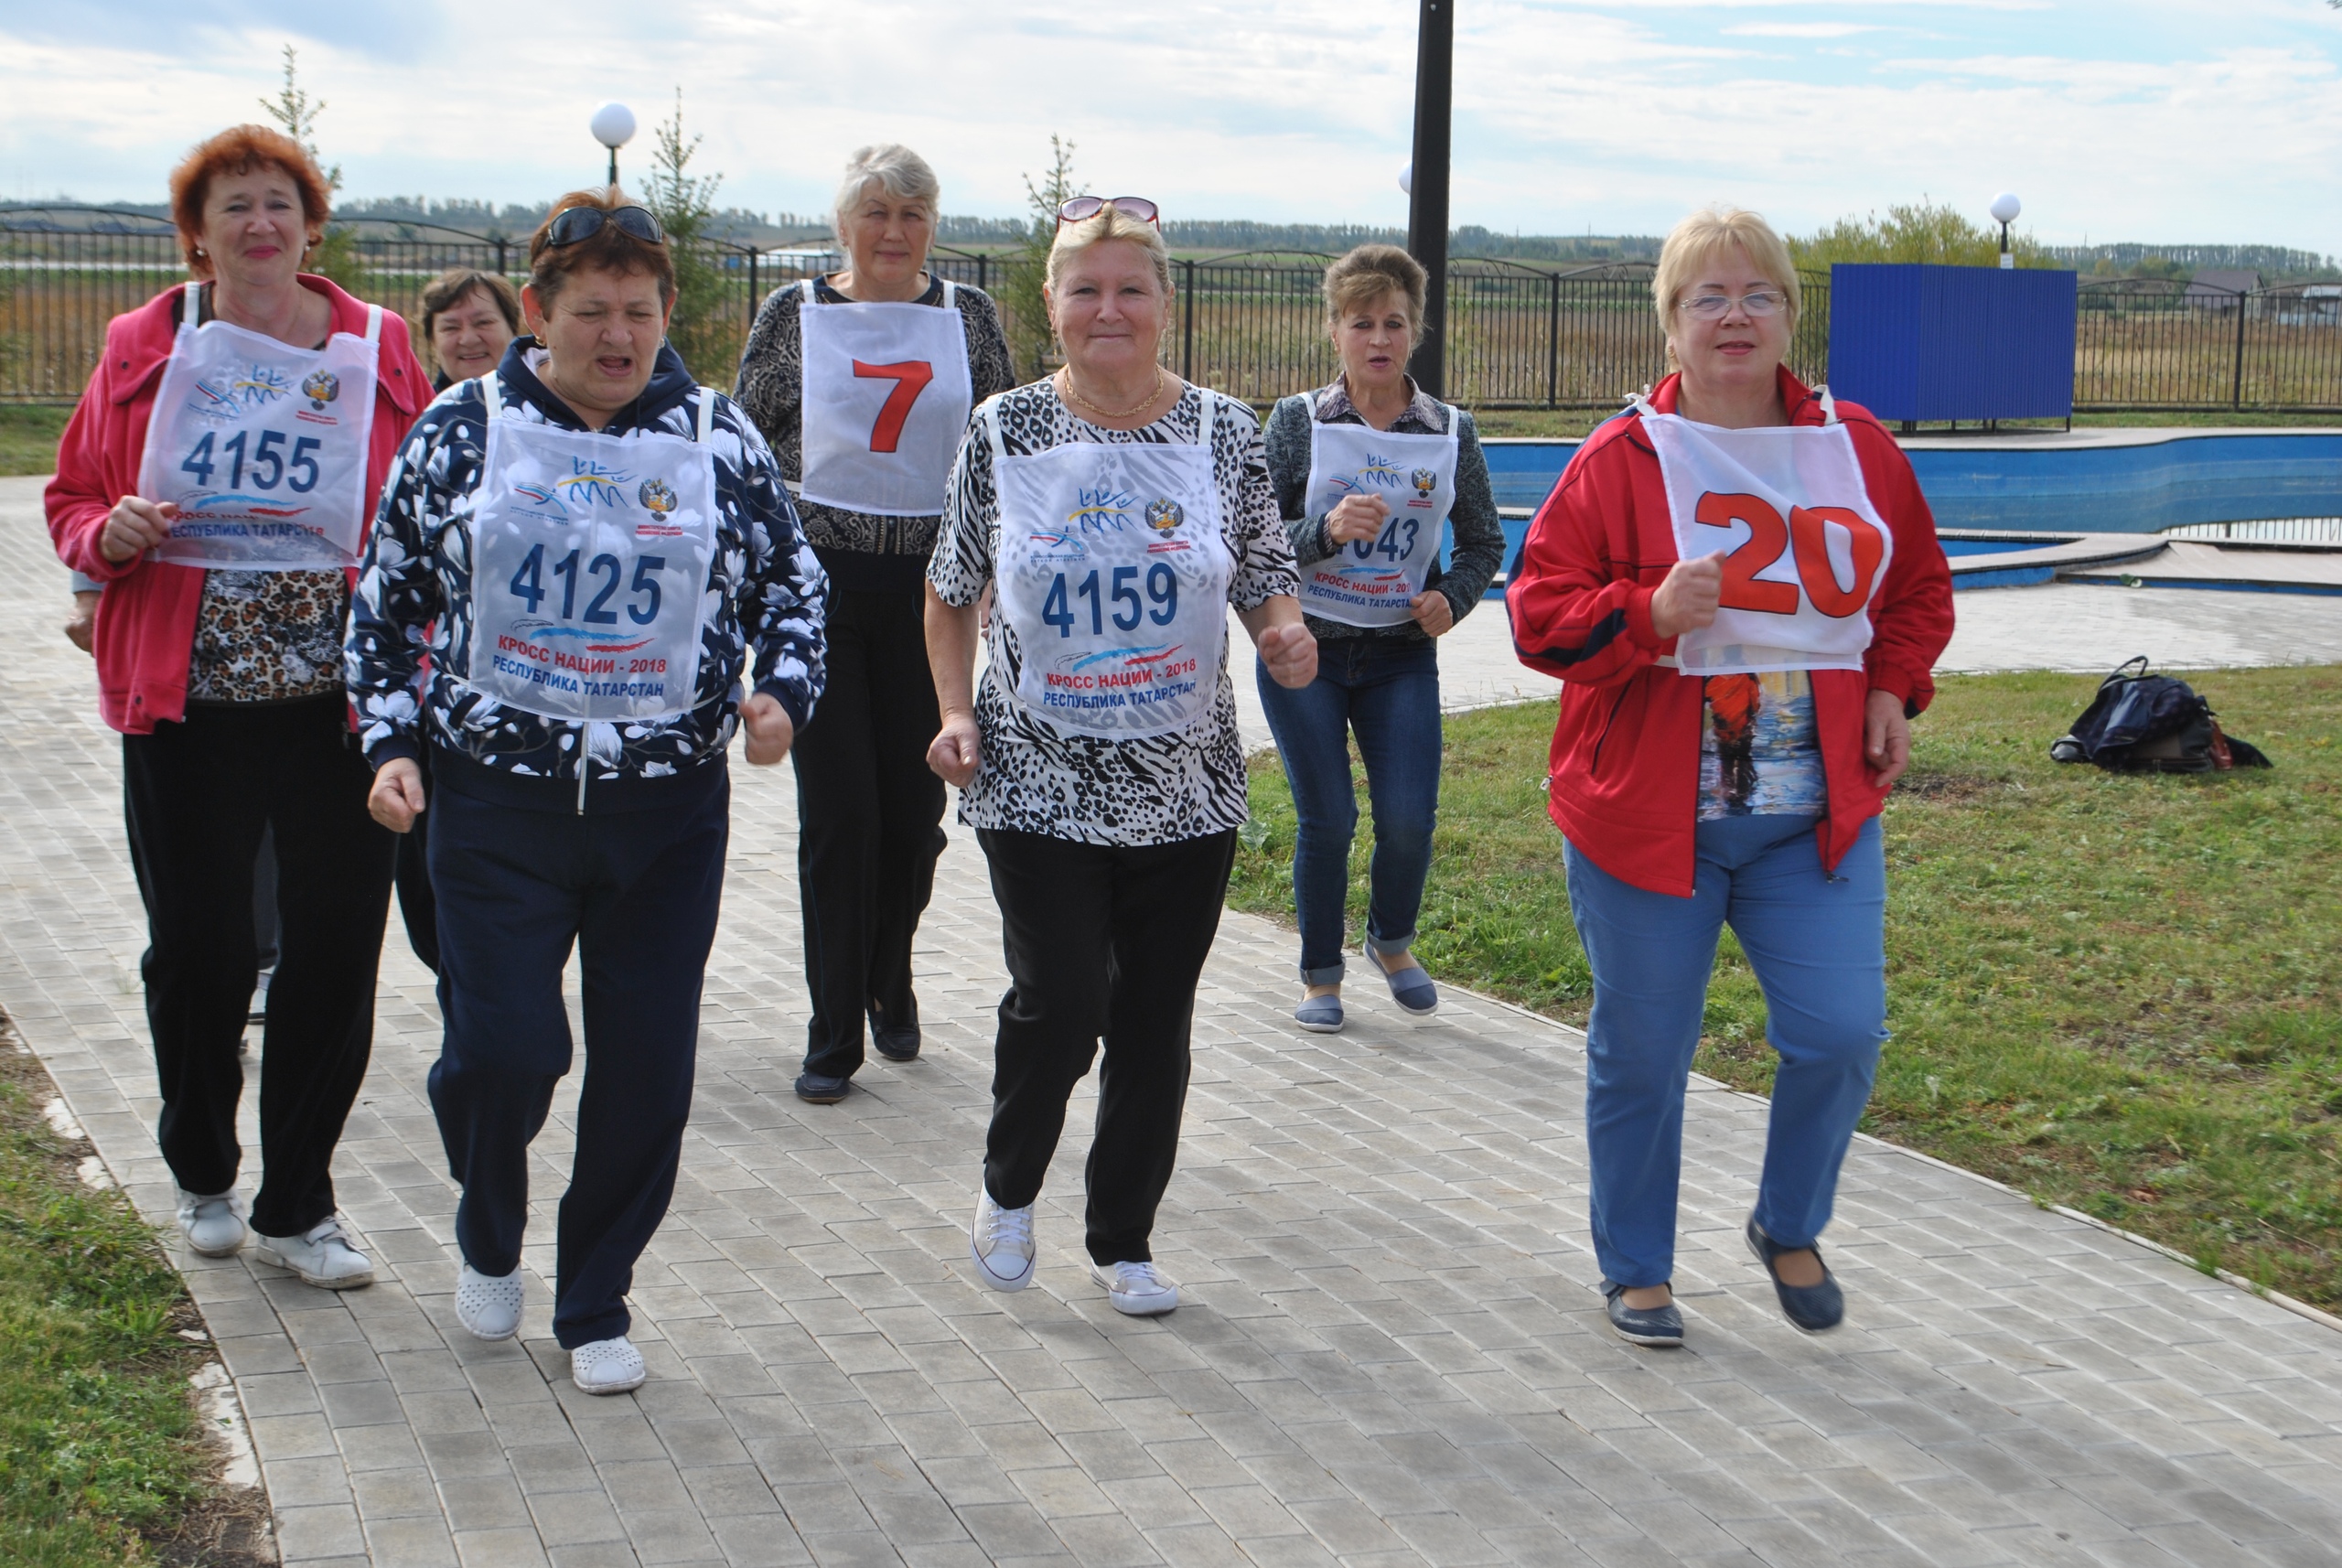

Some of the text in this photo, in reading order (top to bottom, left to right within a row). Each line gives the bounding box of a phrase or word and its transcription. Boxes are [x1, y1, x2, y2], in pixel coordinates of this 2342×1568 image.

[852, 358, 934, 454] 7
[180, 429, 322, 493] 4155
[171, 523, 250, 538] ЕСПУБЛИКА
[175, 510, 216, 522] РОСС
[1337, 517, 1420, 563] 43
[1694, 489, 1884, 618] 20
[510, 542, 666, 626] 4125
[1041, 562, 1178, 639] 4159
[1307, 585, 1413, 608] РЕСПУБЛИКА ТАТАРСТА
[1315, 572, 1349, 589] КРОСС
[1351, 582, 1389, 596] НАЦИИ
[492, 654, 664, 697] РЕСПУБЛИКА ТАТАРСТАН
[498, 634, 550, 663] КРОСС
[554, 651, 615, 675] НАЦИИ
[628, 659, 667, 673] 2018
[1047, 672, 1093, 689] КРОСС
[1098, 669, 1153, 688] НАЦИИ
[1166, 658, 1197, 678] 2018
[1043, 679, 1197, 709] РЕСПУБЛИКА ТАТАРСТАН
